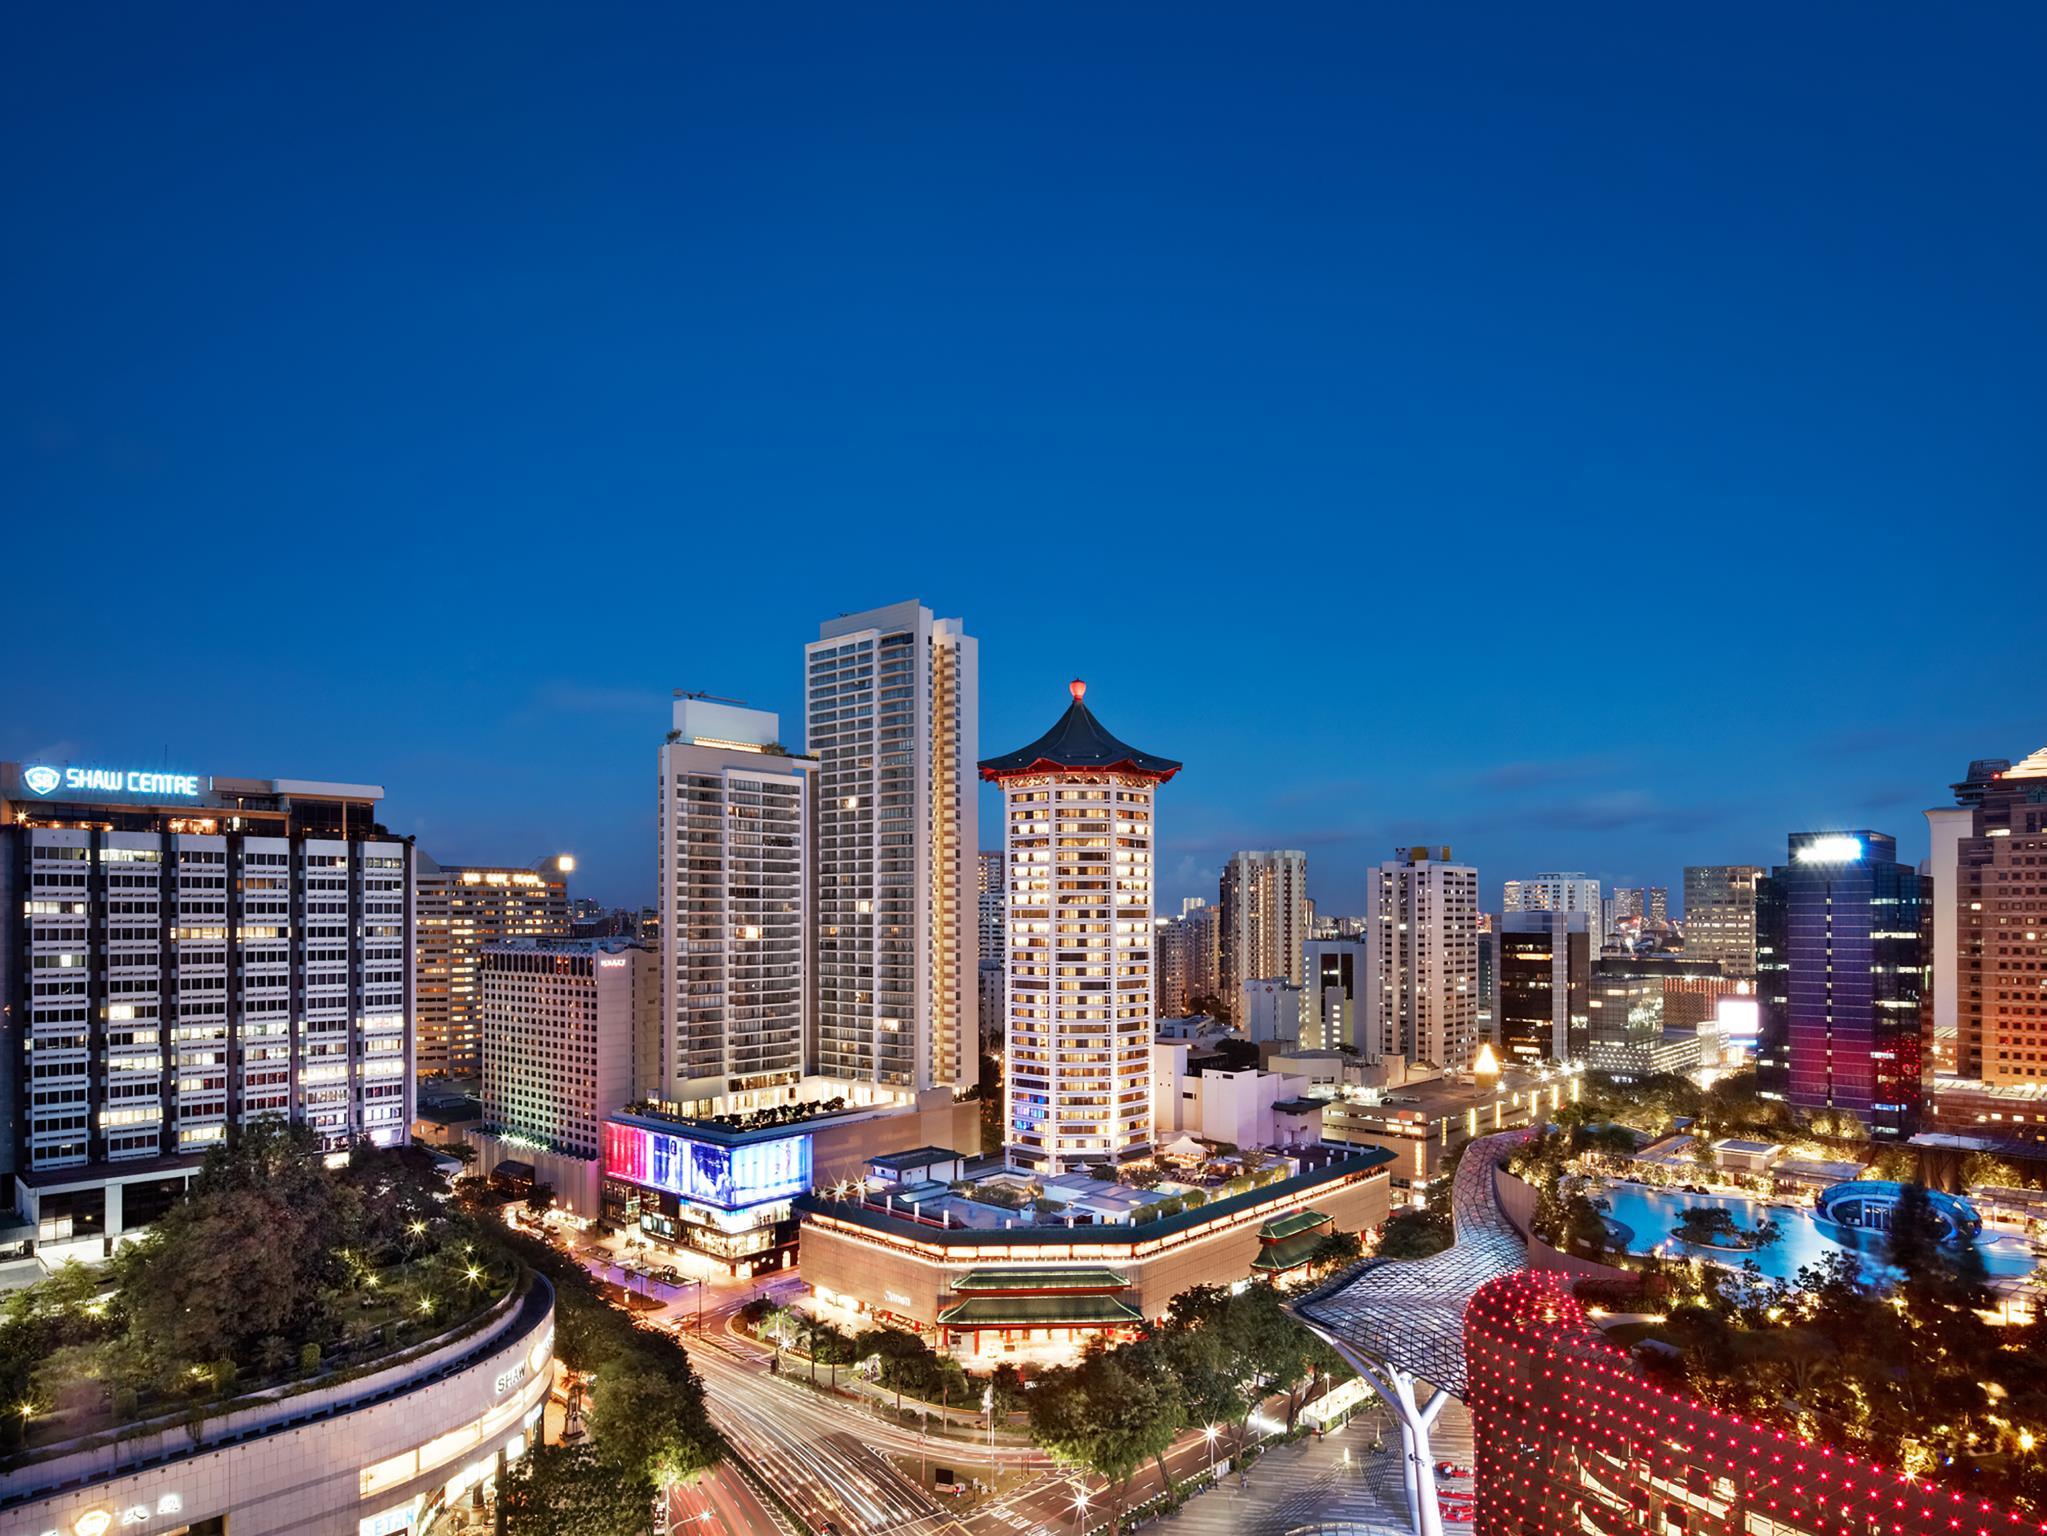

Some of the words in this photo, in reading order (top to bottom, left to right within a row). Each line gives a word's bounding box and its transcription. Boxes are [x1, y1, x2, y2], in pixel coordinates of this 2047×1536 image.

[65, 768, 123, 791] SHAW
[127, 772, 199, 796] CENTRE
[496, 1360, 526, 1394] SHAW
